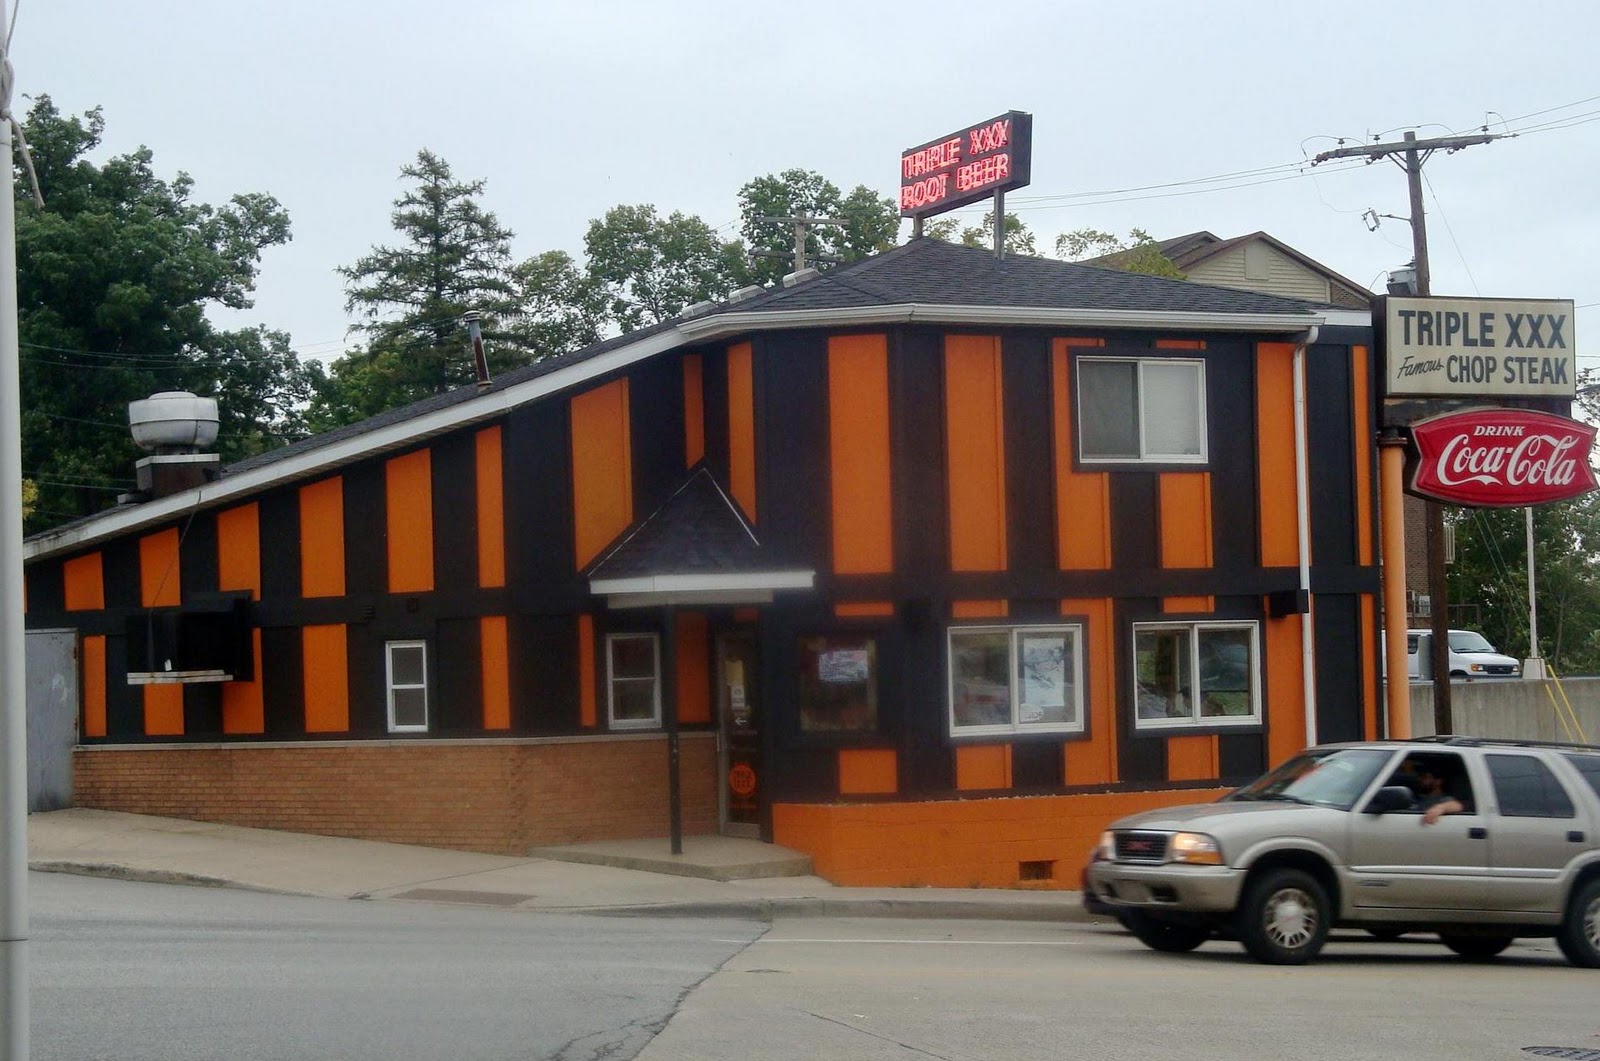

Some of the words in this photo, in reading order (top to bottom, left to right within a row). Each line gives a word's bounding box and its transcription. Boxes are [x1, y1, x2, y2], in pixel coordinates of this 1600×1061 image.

[902, 138, 961, 178] TRIPLE
[970, 120, 1009, 154] XXX
[900, 173, 949, 209] ROOT
[957, 154, 1008, 191] BEER
[1398, 310, 1495, 347] TRIPLE
[1505, 313, 1566, 348] XXX
[1397, 356, 1444, 378] Famous
[1447, 355, 1497, 383] CHOP
[1503, 357, 1568, 384] STEAK
[1473, 426, 1526, 436] DRINK
[1437, 434, 1580, 485] Coca-Cola
